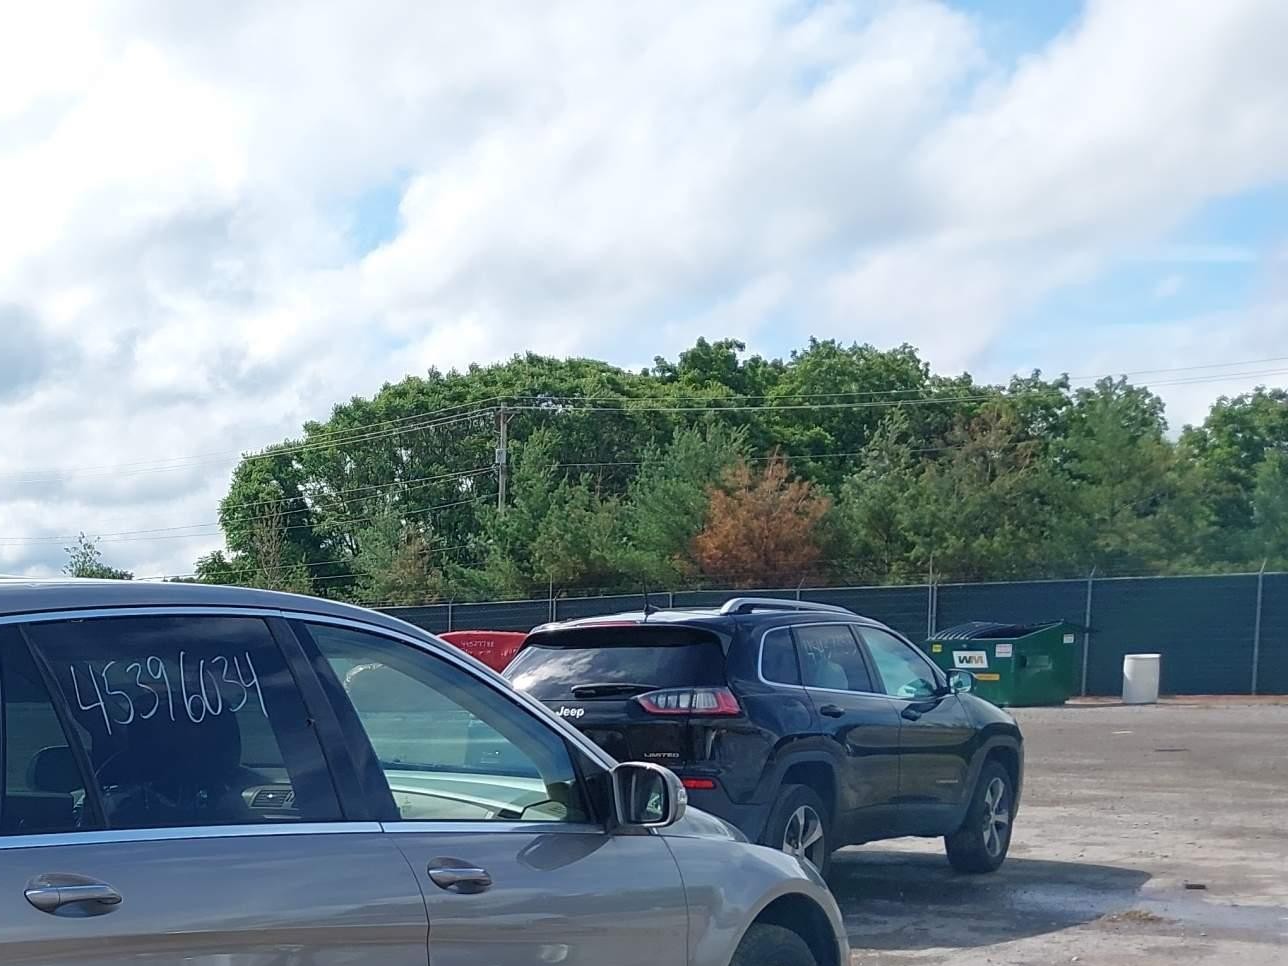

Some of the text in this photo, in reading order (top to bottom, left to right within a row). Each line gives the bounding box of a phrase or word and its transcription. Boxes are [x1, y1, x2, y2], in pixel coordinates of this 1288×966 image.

[957, 655, 984, 664] WM
[70, 650, 269, 736] 45396034
[555, 706, 585, 719] Jeep
